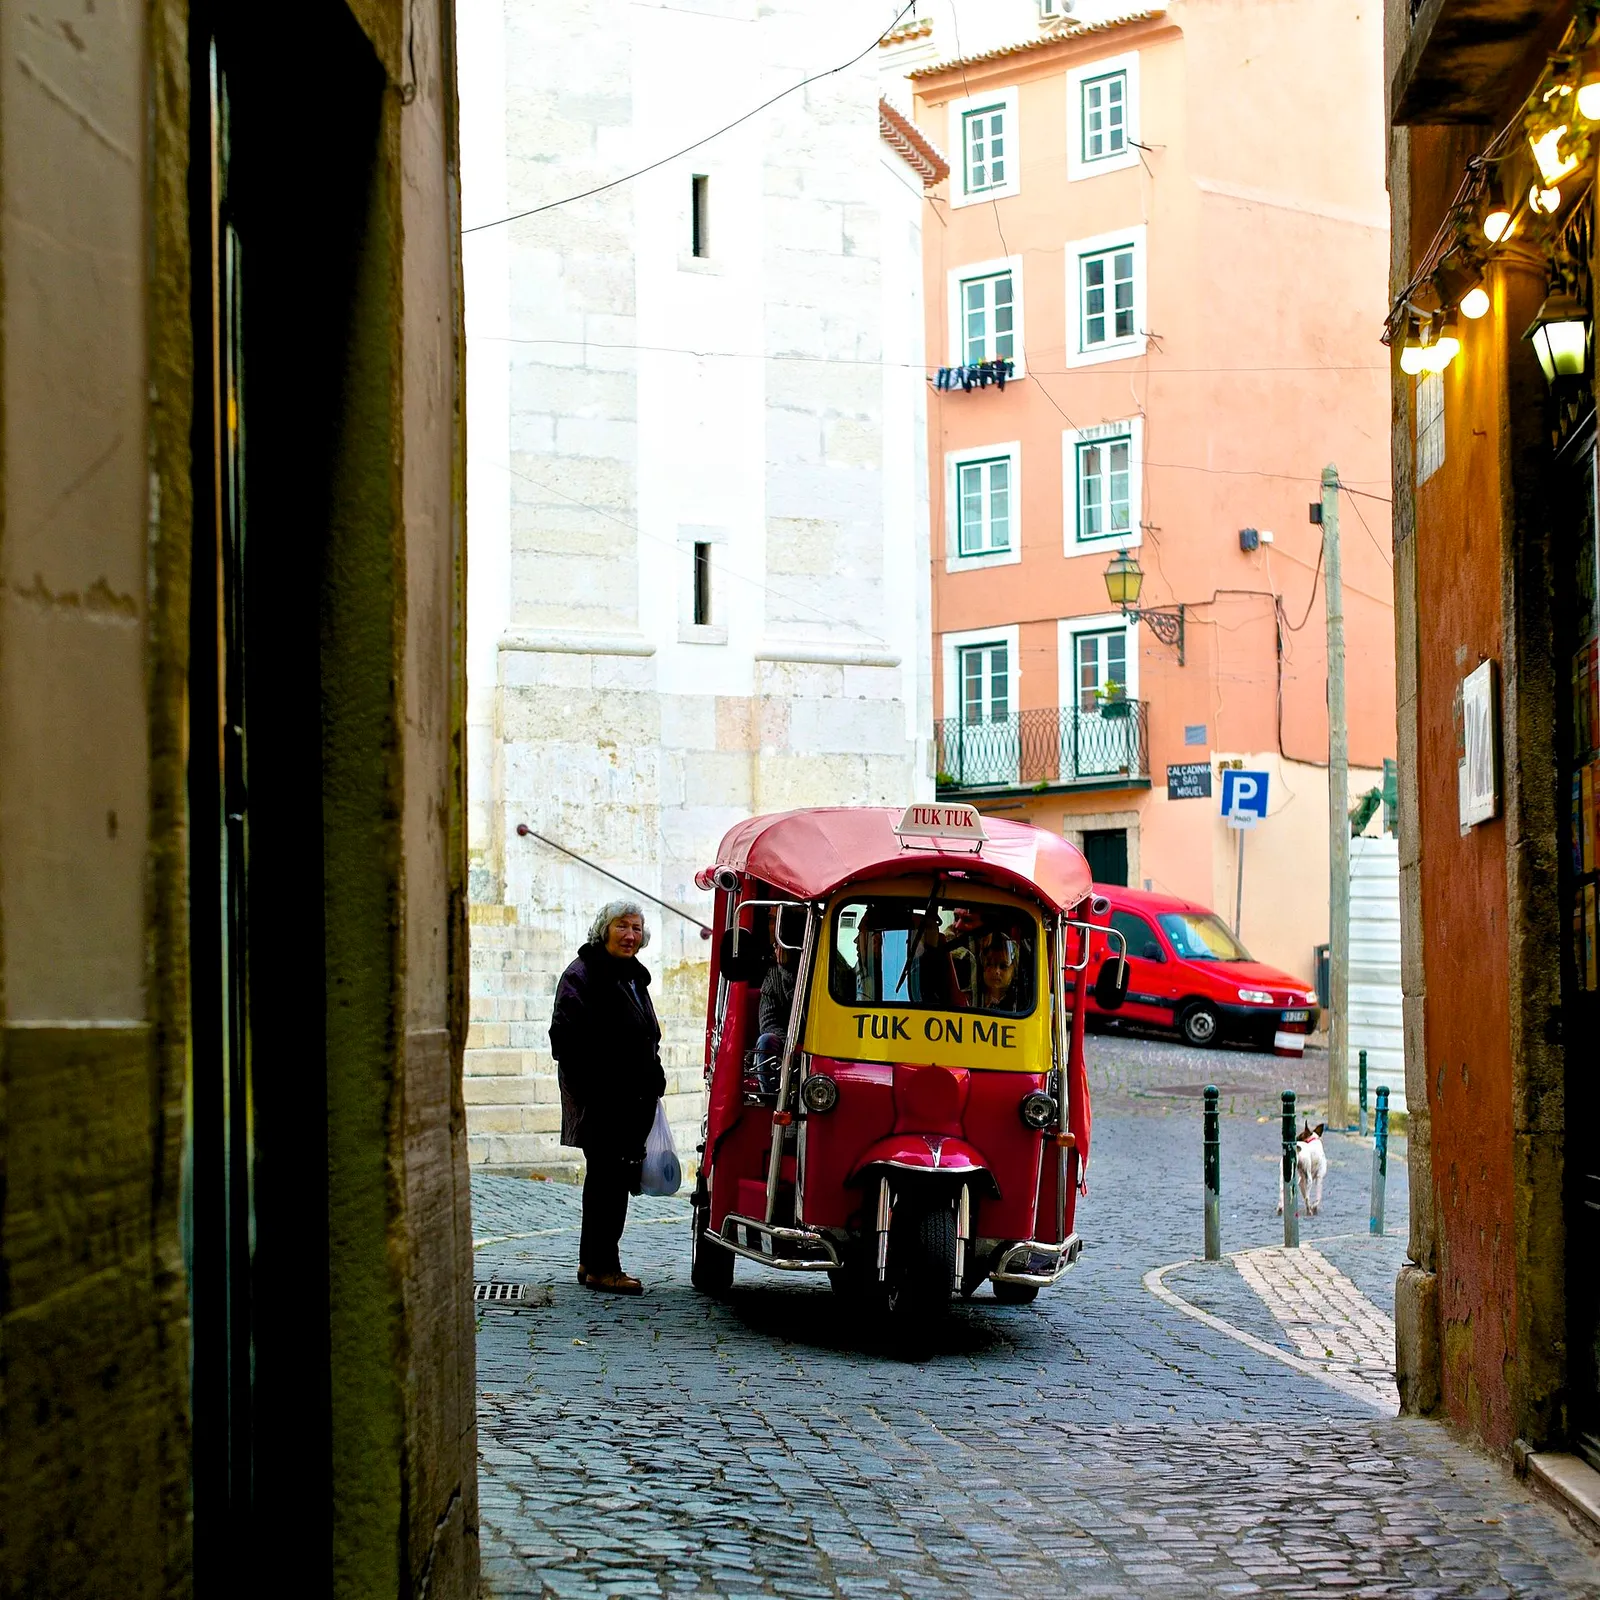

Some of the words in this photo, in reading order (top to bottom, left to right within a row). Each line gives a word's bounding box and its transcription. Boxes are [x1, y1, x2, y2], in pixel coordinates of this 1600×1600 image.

[1177, 786, 1204, 797] MIGUEL
[1232, 776, 1258, 809] P
[913, 808, 941, 825] TUK
[945, 810, 974, 827] TUK
[852, 1014, 912, 1040] TUK
[924, 1016, 963, 1044] ON
[972, 1020, 1017, 1048] ME
